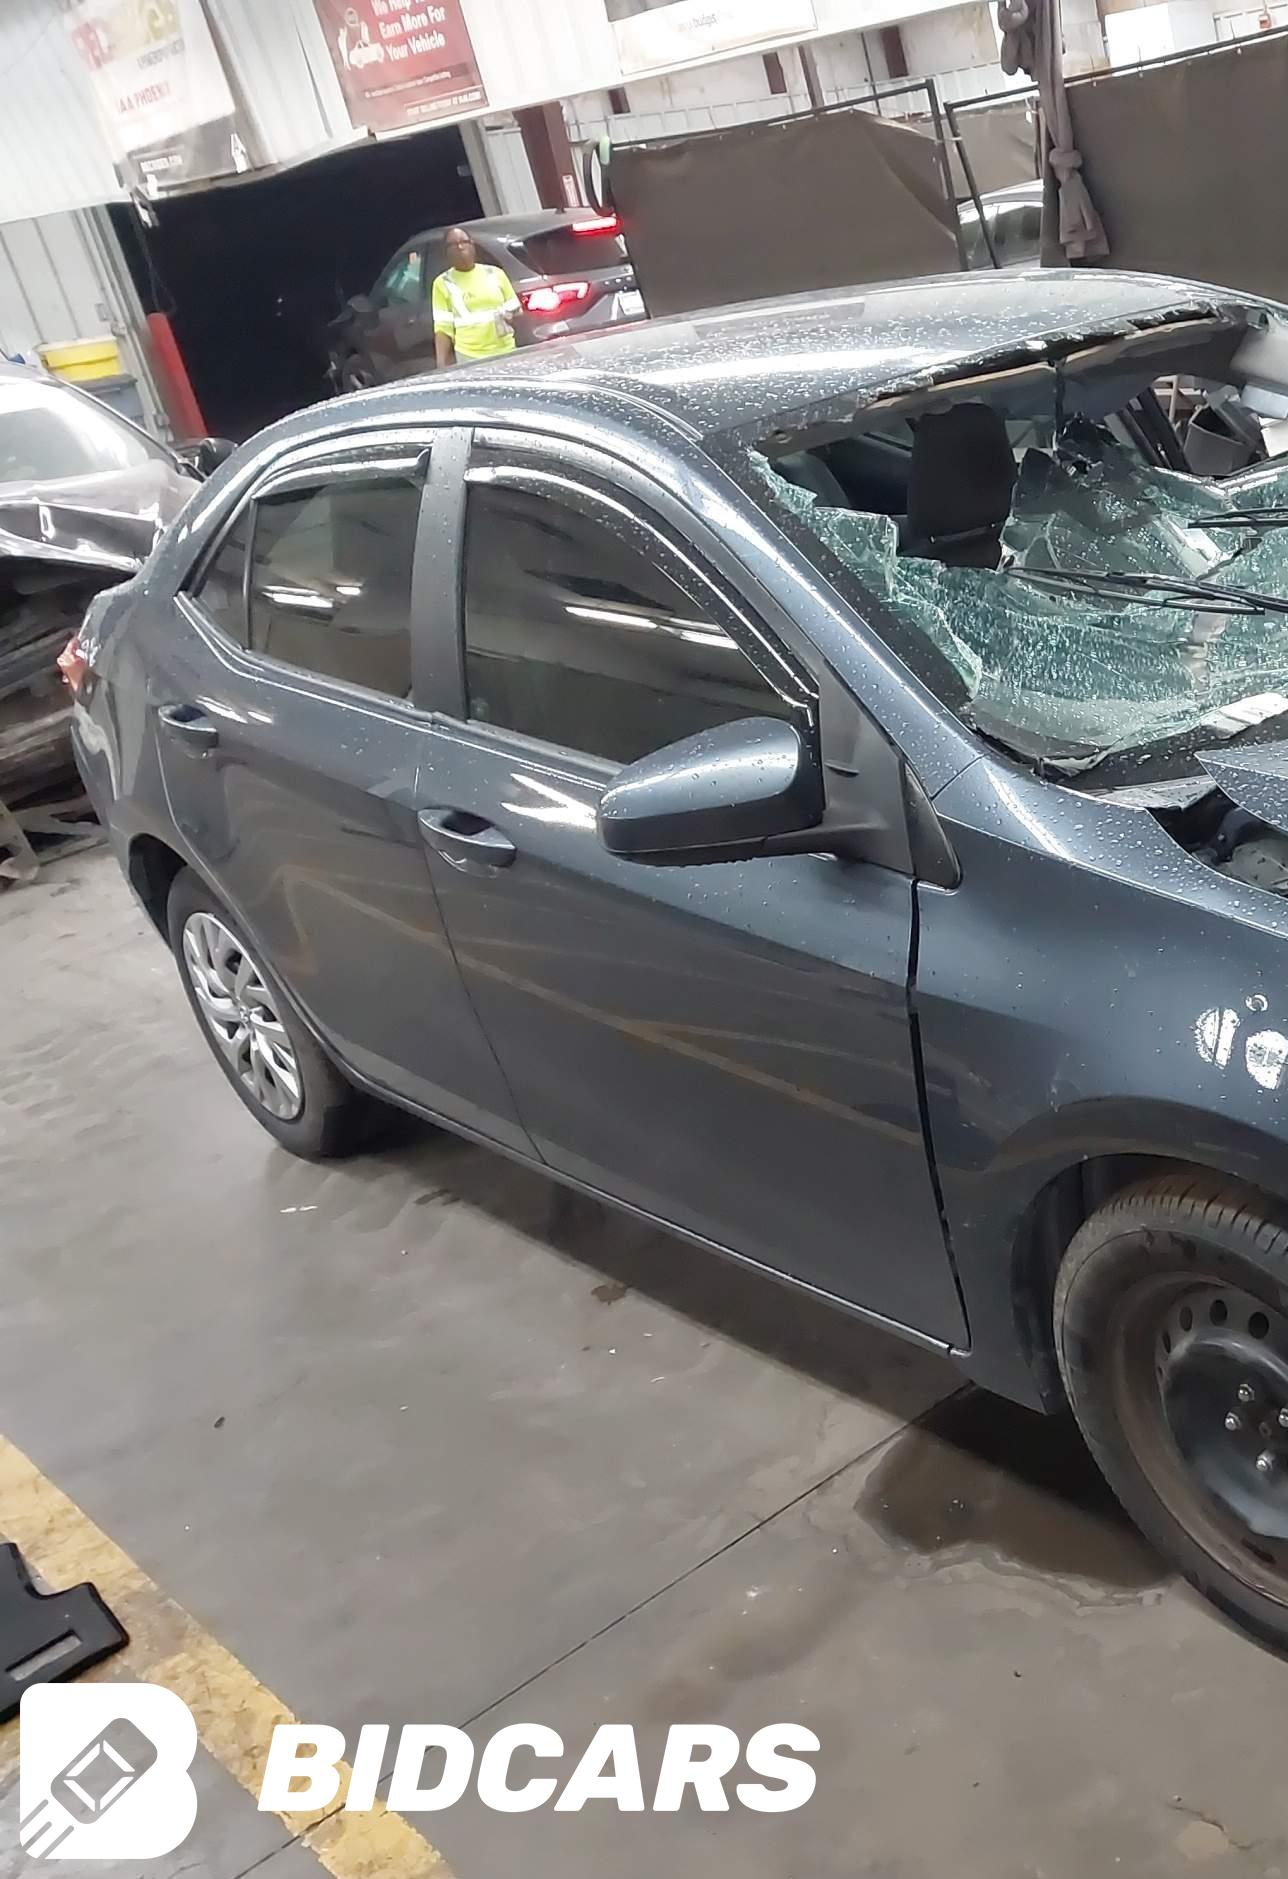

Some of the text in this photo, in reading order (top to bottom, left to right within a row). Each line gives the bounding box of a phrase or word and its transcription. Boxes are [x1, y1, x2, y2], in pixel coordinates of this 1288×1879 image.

[380, 5, 445, 38] Earn More For
[386, 30, 445, 61] Your Vehicle
